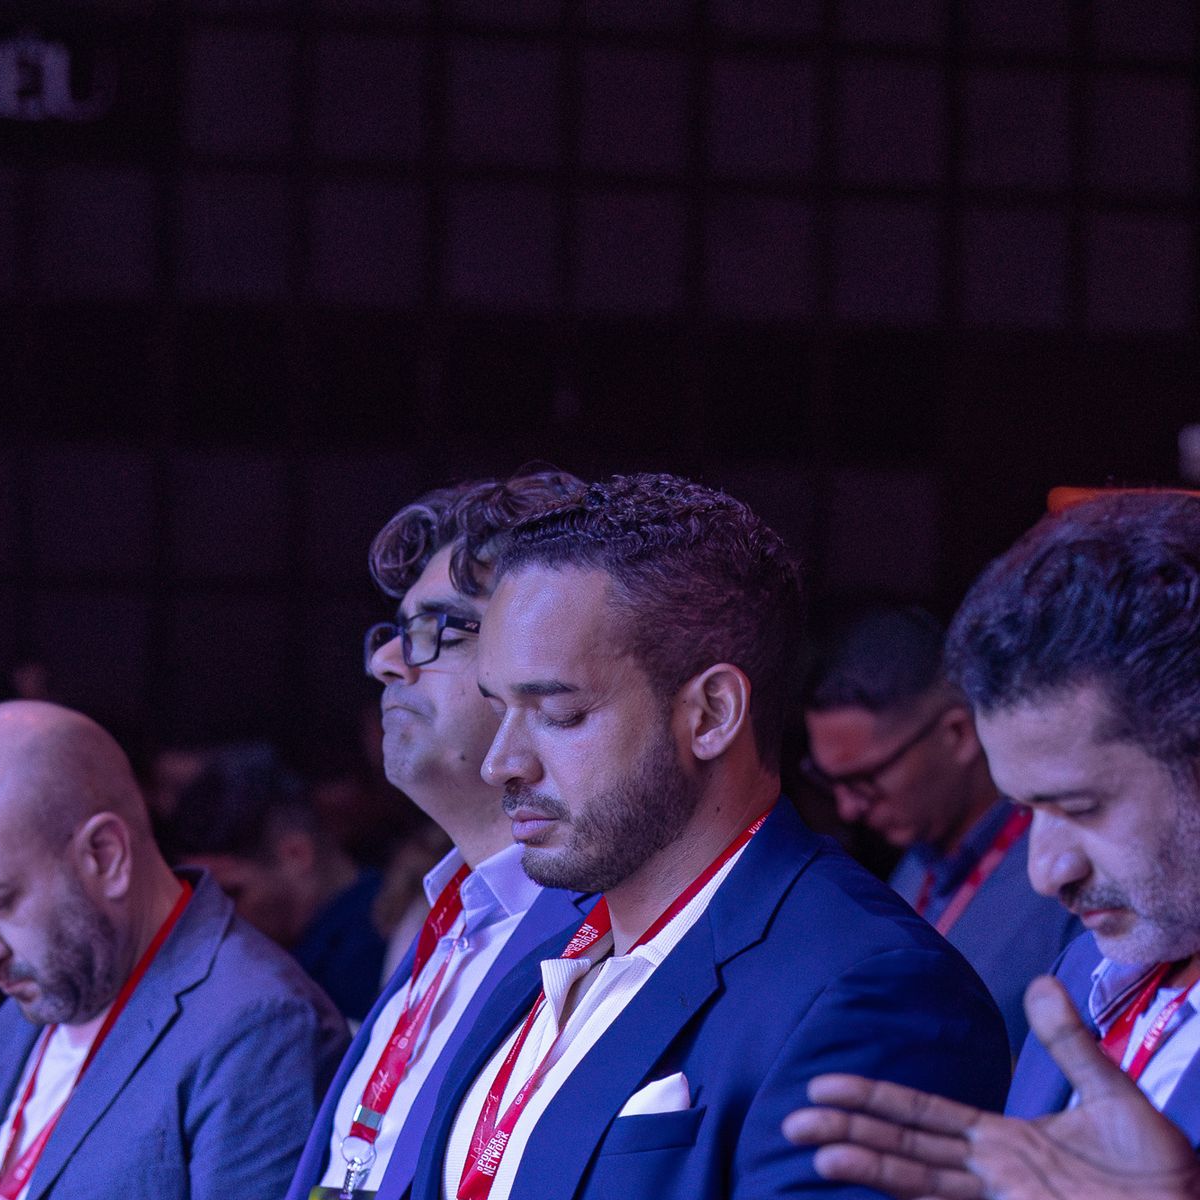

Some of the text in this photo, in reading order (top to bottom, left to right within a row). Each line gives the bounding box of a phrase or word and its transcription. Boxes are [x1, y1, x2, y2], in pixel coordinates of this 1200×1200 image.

[573, 933, 599, 952] PODER
[478, 1138, 498, 1167] PODER
[482, 1132, 510, 1177] NETWORK
